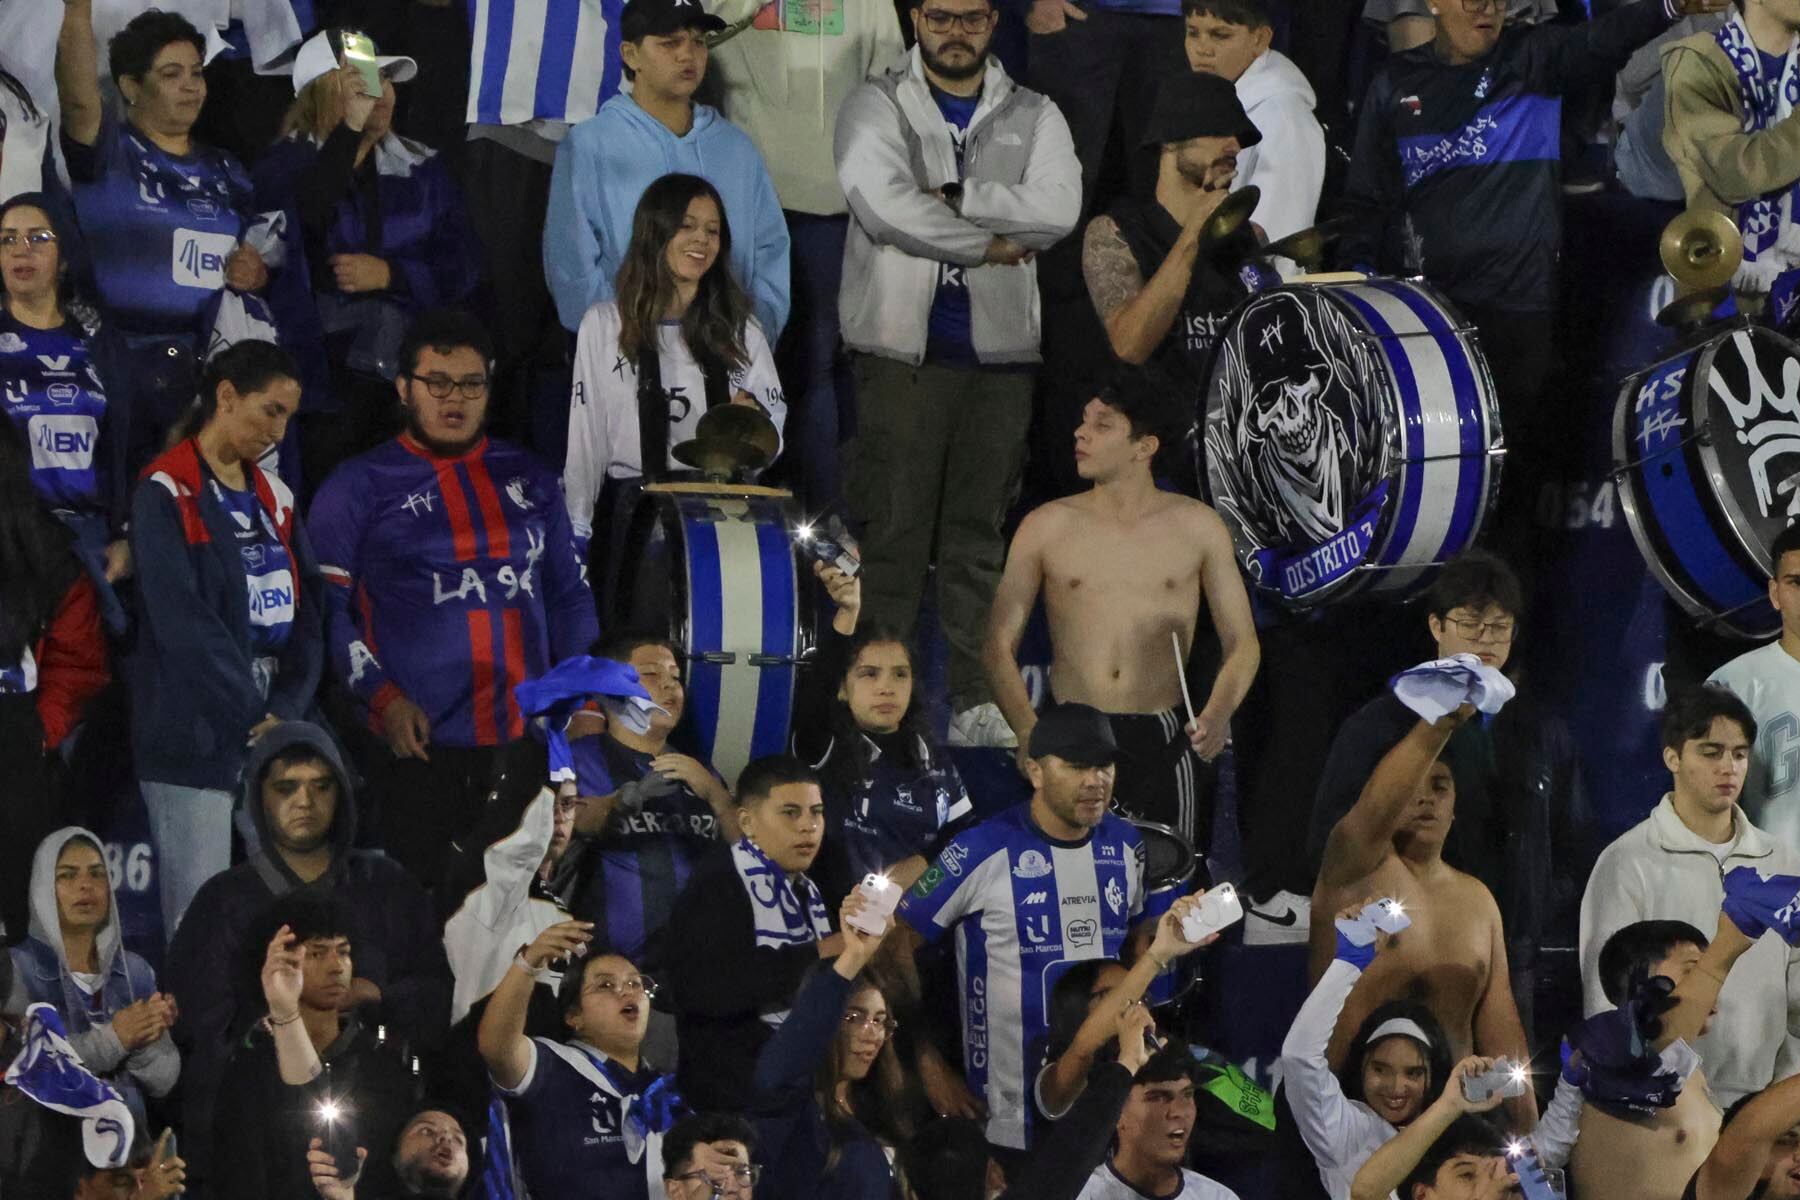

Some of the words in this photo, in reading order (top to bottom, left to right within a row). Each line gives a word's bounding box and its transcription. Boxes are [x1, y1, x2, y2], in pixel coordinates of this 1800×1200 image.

[58, 431, 92, 453] BN
[1284, 536, 1360, 595] DISTRITO
[432, 566, 488, 604] LA
[262, 588, 291, 611] BN
[1062, 896, 1097, 907] ATREVIA
[1019, 944, 1033, 954] San
[1036, 943, 1063, 952] Marcos
